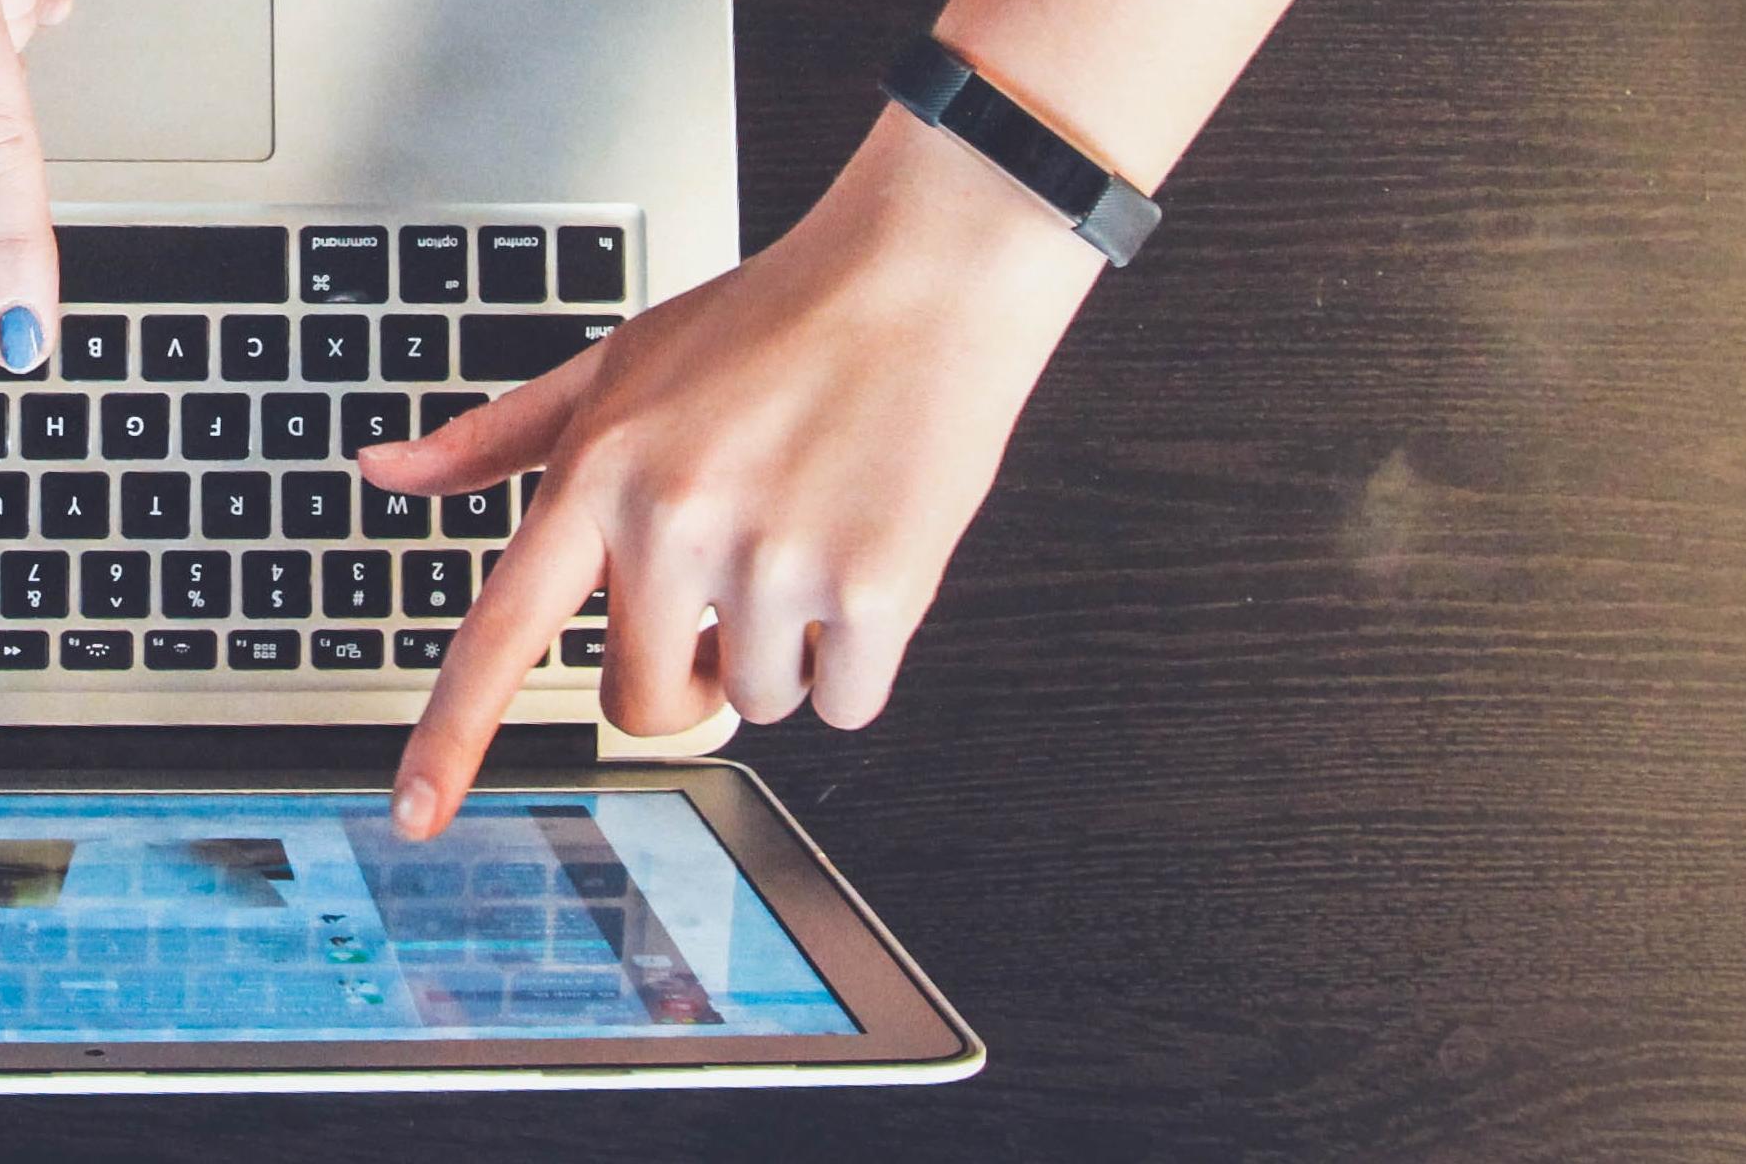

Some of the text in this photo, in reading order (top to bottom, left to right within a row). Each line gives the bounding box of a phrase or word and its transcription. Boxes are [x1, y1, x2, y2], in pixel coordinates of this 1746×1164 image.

[311, 236, 378, 250] command
[417, 235, 459, 249] option
[493, 236, 539, 249] control
[598, 237, 614, 251] fn
[87, 337, 103, 358] B
[167, 338, 184, 358] V
[247, 337, 263, 358] C
[327, 338, 344, 357] X
[407, 337, 422, 357] Z
[46, 416, 64, 437] H
[126, 416, 145, 437] G
[209, 416, 222, 437] F
[287, 416, 304, 437] D
[370, 416, 383, 436] S
[67, 496, 82, 516] Y
[149, 496, 163, 516] T
[229, 495, 244, 516] R
[311, 495, 323, 516] E
[387, 495, 408, 515] W
[468, 494, 487, 515] Q
[27, 563, 41, 582] 7
[110, 563, 123, 582] 6
[190, 563, 203, 582] 5
[271, 563, 284, 582] 4
[352, 562, 365, 581] 3
[431, 562, 444, 581] 2
[27, 590, 42, 608] &
[109, 596, 123, 608] ^
[187, 590, 206, 608] %
[271, 589, 283, 608] $
[352, 590, 365, 606] #
[429, 591, 446, 607] @
